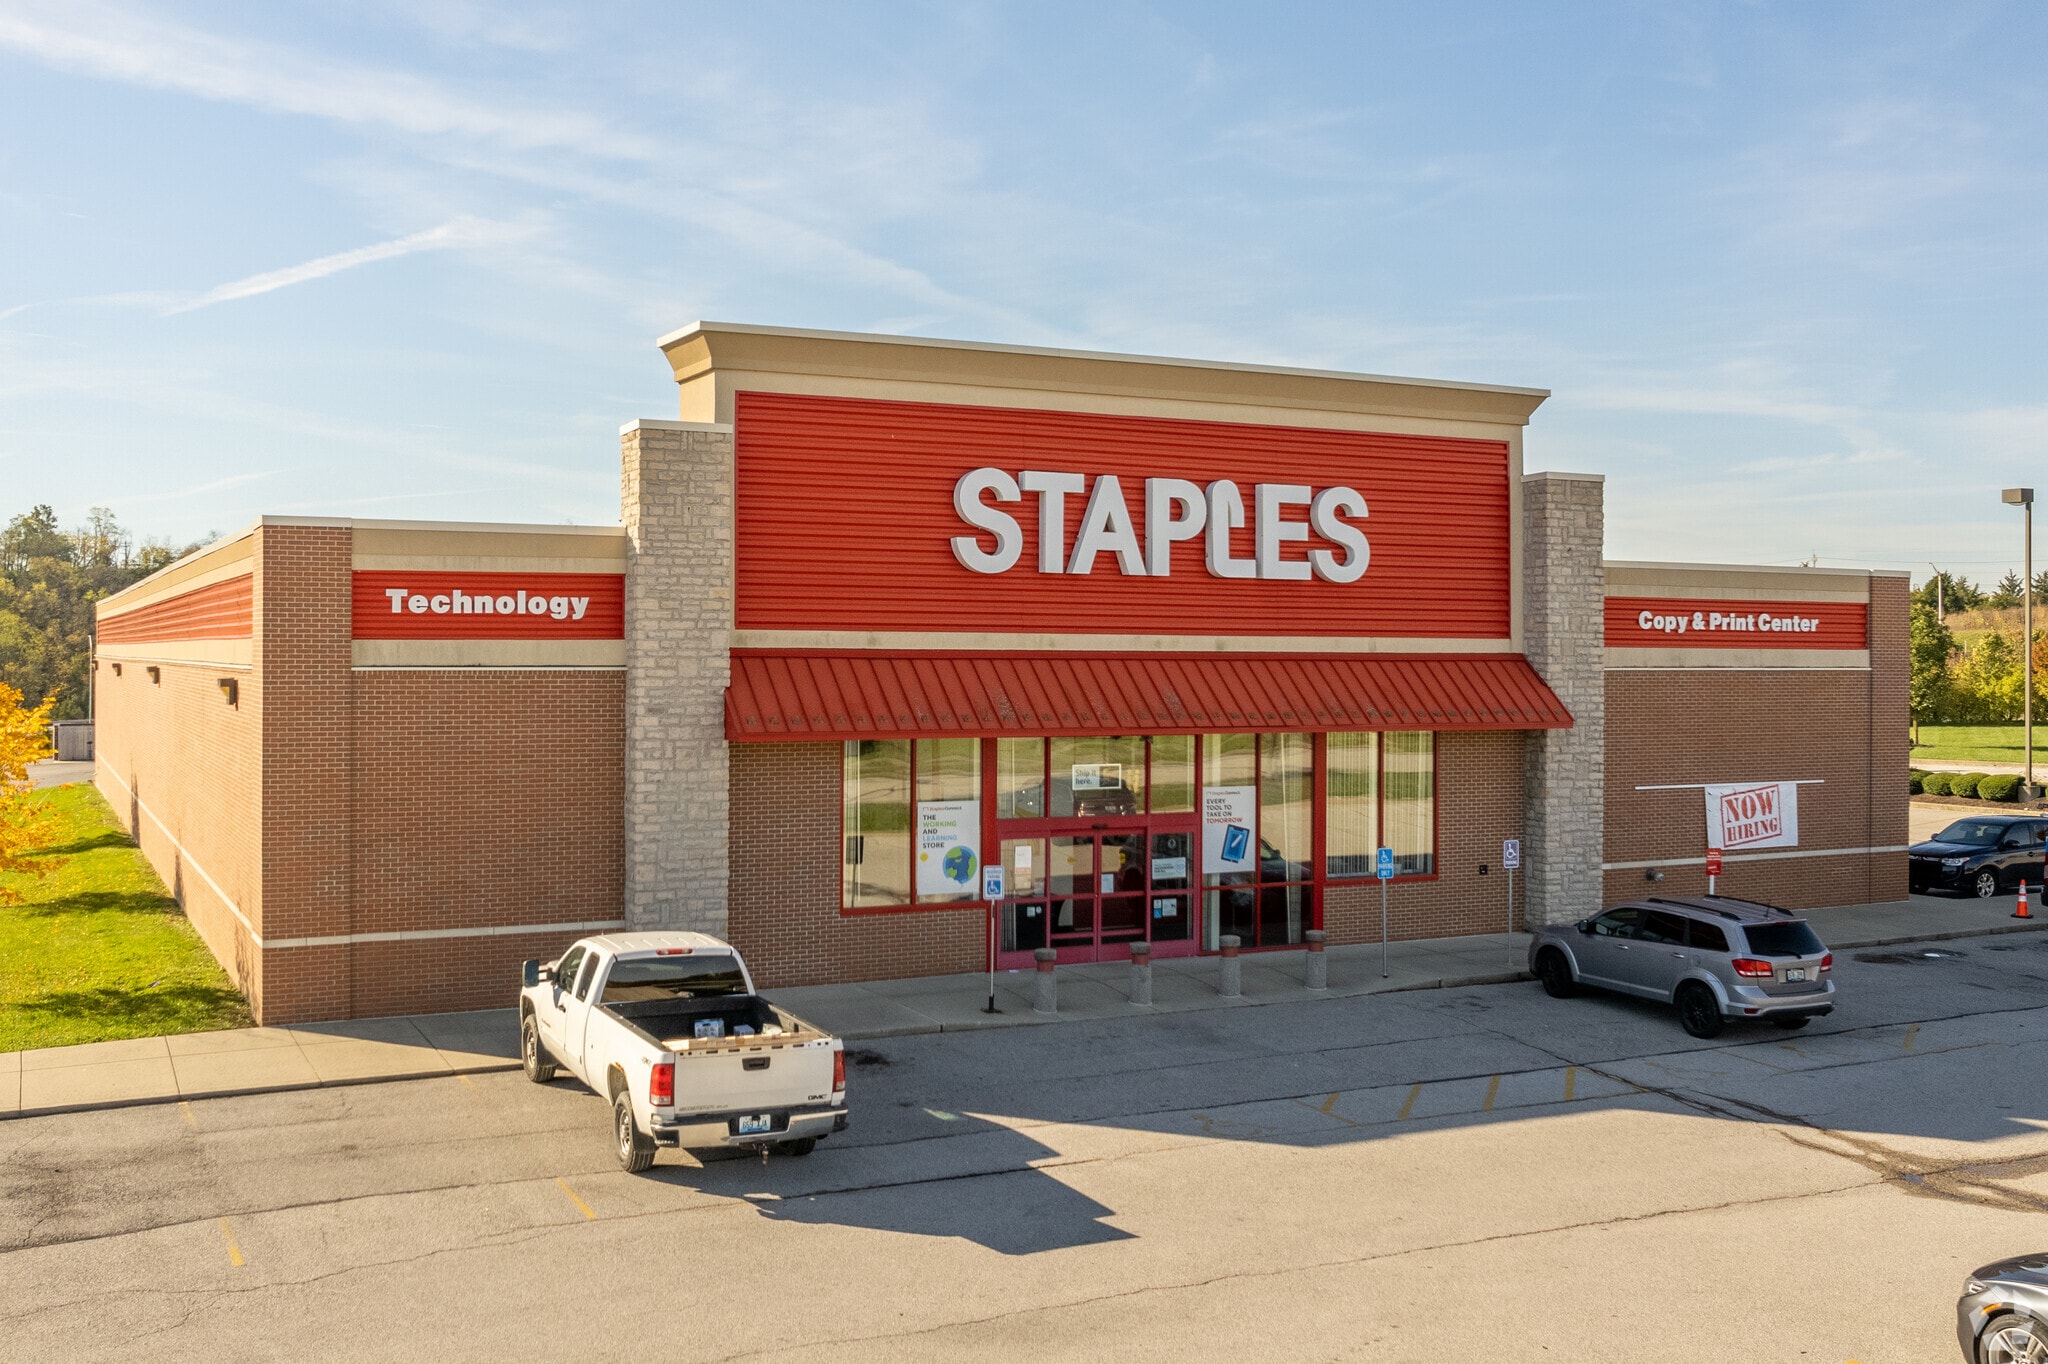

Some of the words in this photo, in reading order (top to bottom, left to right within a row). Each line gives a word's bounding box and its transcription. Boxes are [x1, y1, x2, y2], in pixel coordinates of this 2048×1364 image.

[950, 467, 1370, 583] STAPLES
[385, 588, 590, 620] Technology
[1638, 610, 1689, 633] Copy
[1692, 611, 1706, 631] &
[1709, 612, 1755, 632] Print
[1758, 613, 1820, 632] Center
[1724, 790, 1775, 823] NOW
[923, 820, 957, 828] WORKING
[1727, 817, 1778, 842] HIRING
[923, 834, 958, 842] LEARNING
